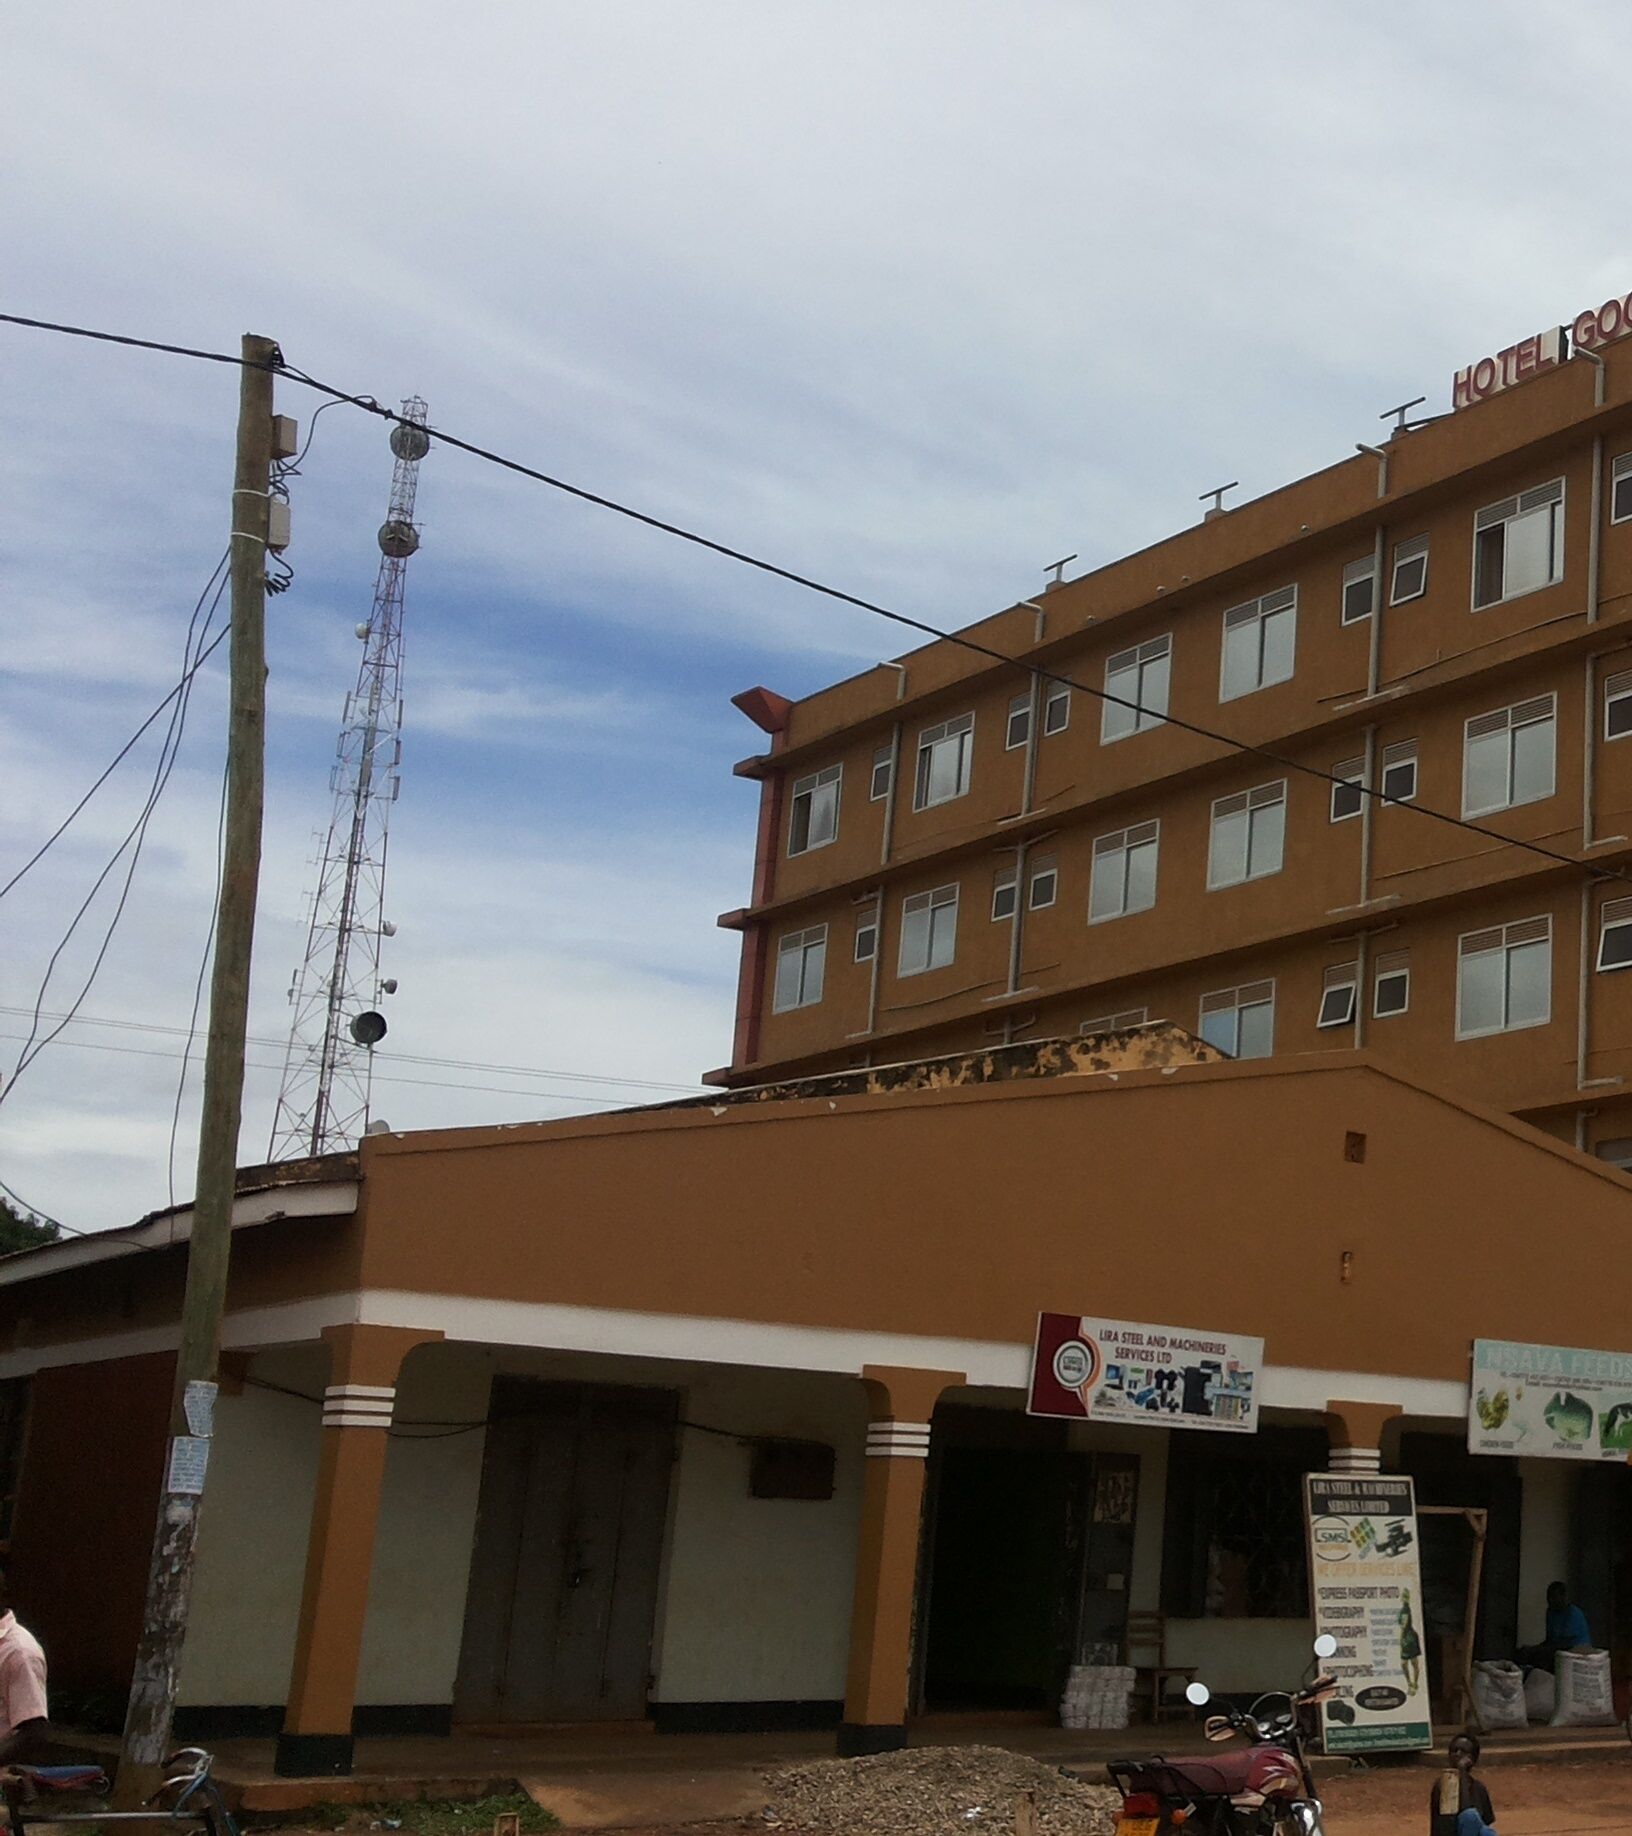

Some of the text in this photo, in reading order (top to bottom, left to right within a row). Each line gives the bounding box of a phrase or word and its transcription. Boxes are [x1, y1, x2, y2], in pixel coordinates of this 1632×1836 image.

[1452, 332, 1555, 409] HOTEL
[1099, 1329, 1119, 1343] LIRA
[1121, 1331, 1145, 1346] STEEL
[1146, 1334, 1166, 1349] AND
[1114, 1346, 1173, 1365] SERVICES LTD
[1320, 1531, 1344, 1542] SMS
